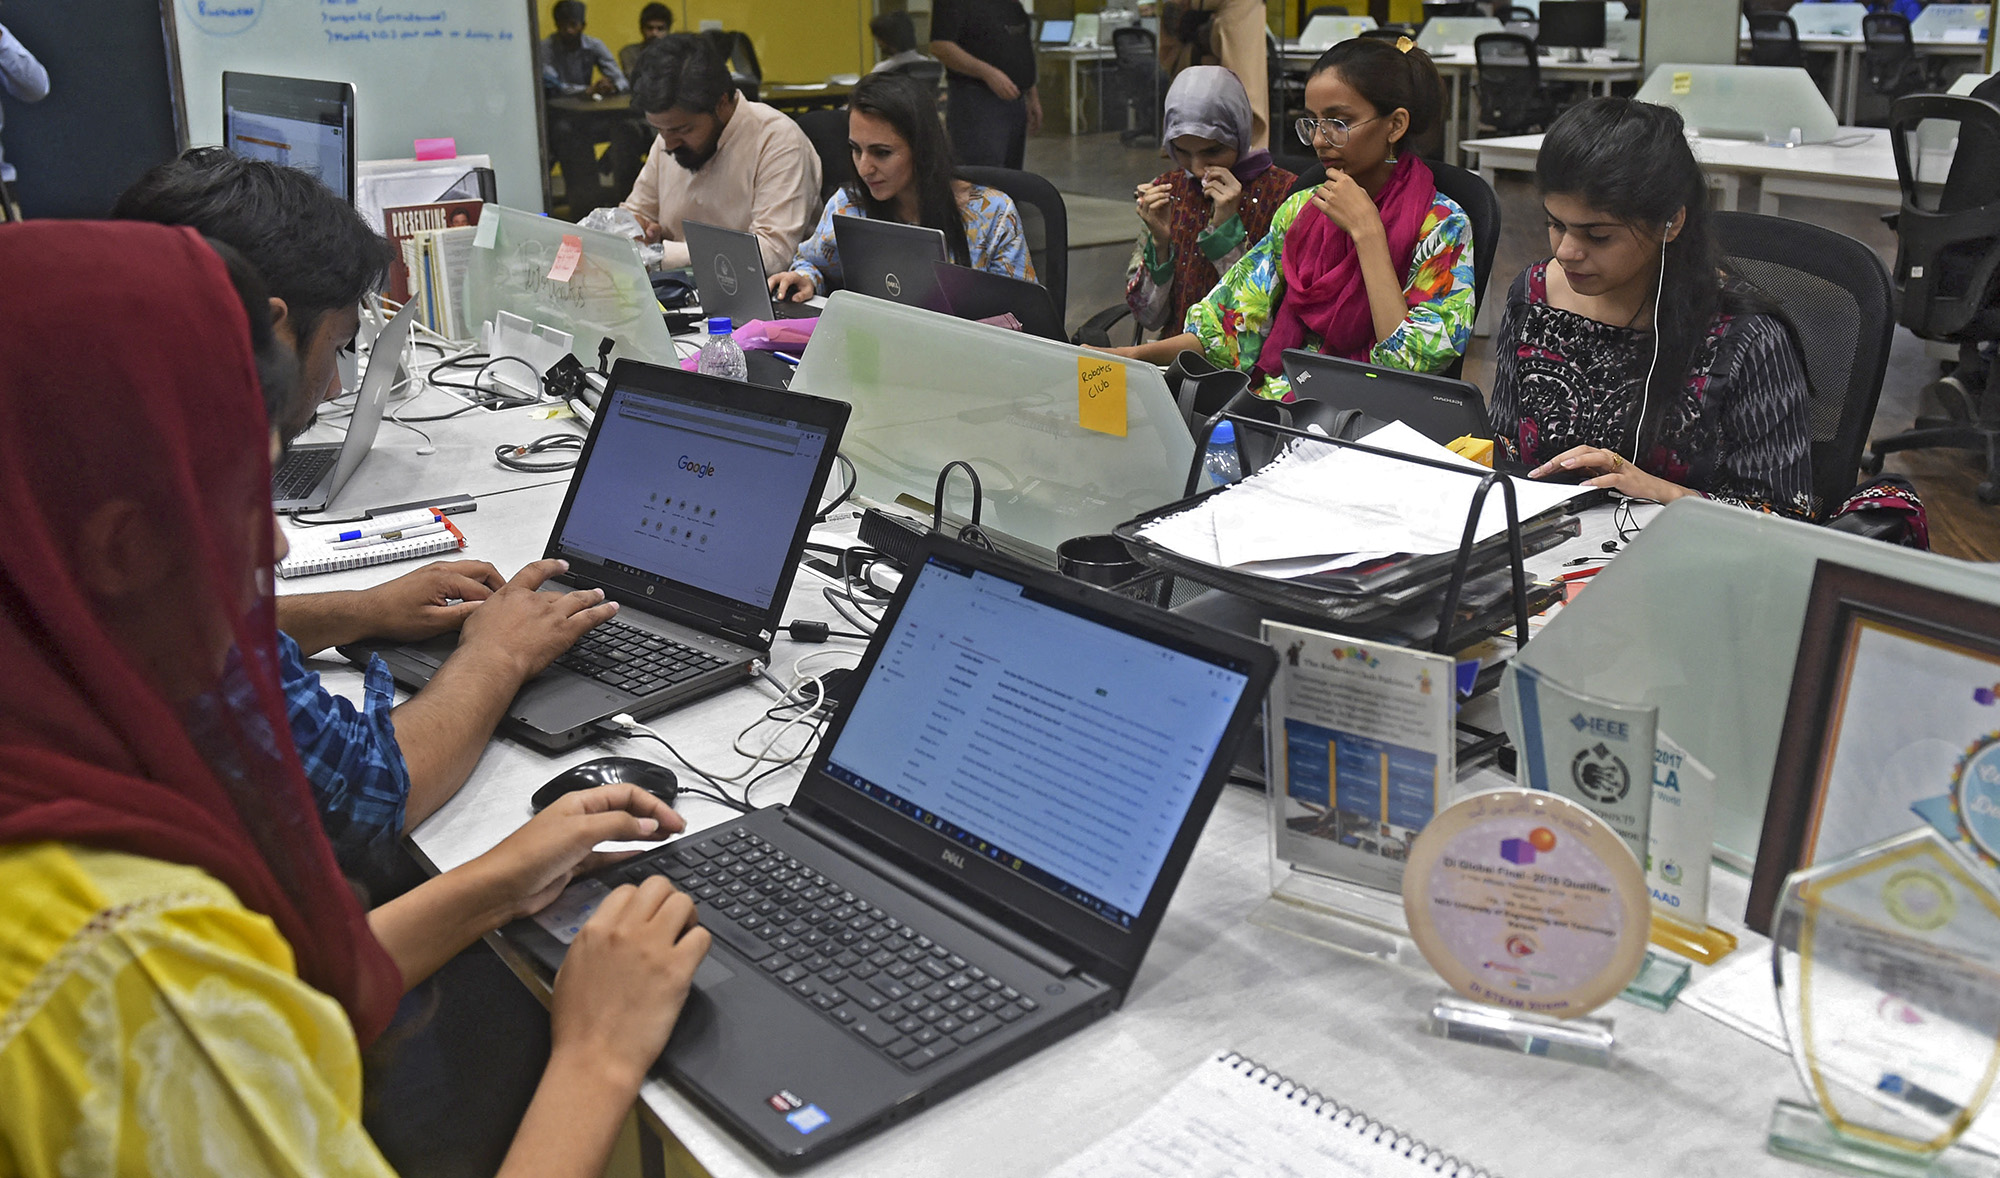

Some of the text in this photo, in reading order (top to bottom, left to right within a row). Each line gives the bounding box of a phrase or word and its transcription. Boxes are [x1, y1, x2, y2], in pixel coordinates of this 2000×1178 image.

[391, 207, 447, 238] PRESENTING
[1088, 380, 1110, 399] Club
[677, 455, 715, 479] Google
[1590, 717, 1629, 737] IEEE
[1655, 748, 1683, 769] 2017
[941, 849, 966, 869] DELL
